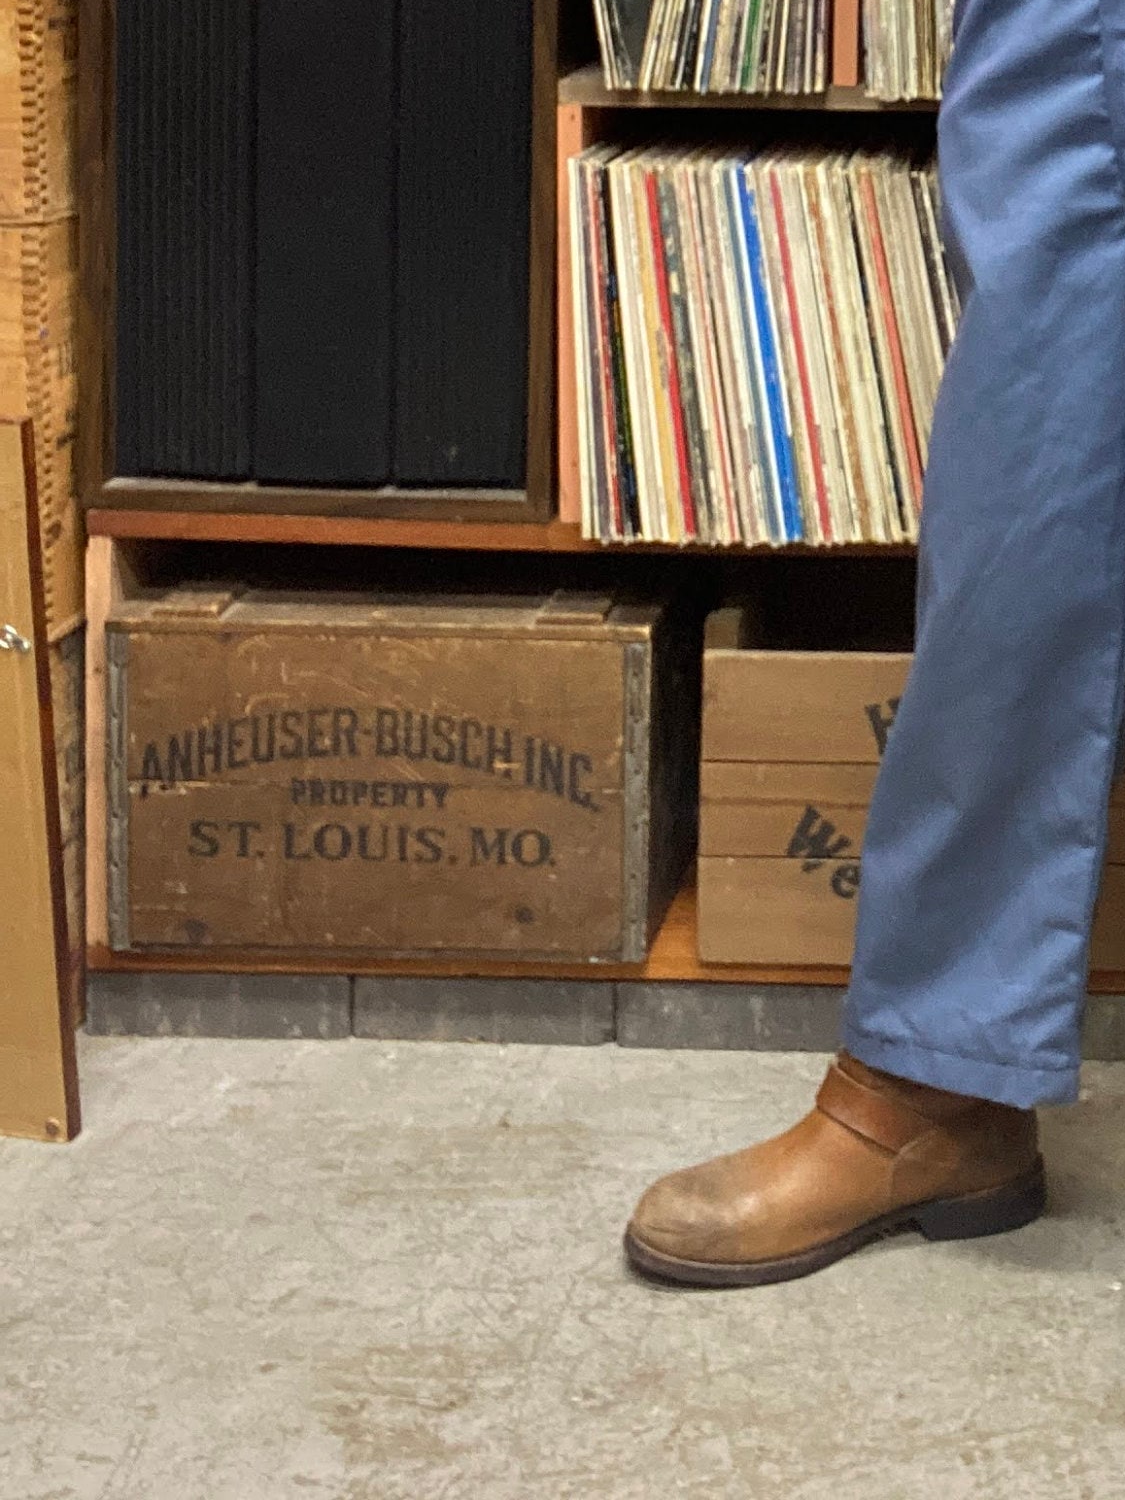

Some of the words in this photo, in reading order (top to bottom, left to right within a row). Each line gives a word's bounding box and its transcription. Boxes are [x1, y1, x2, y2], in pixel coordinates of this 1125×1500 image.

[290, 777, 451, 809] PROPERTY
[187, 819, 265, 858] ST.
[469, 826, 557, 868] MO.
